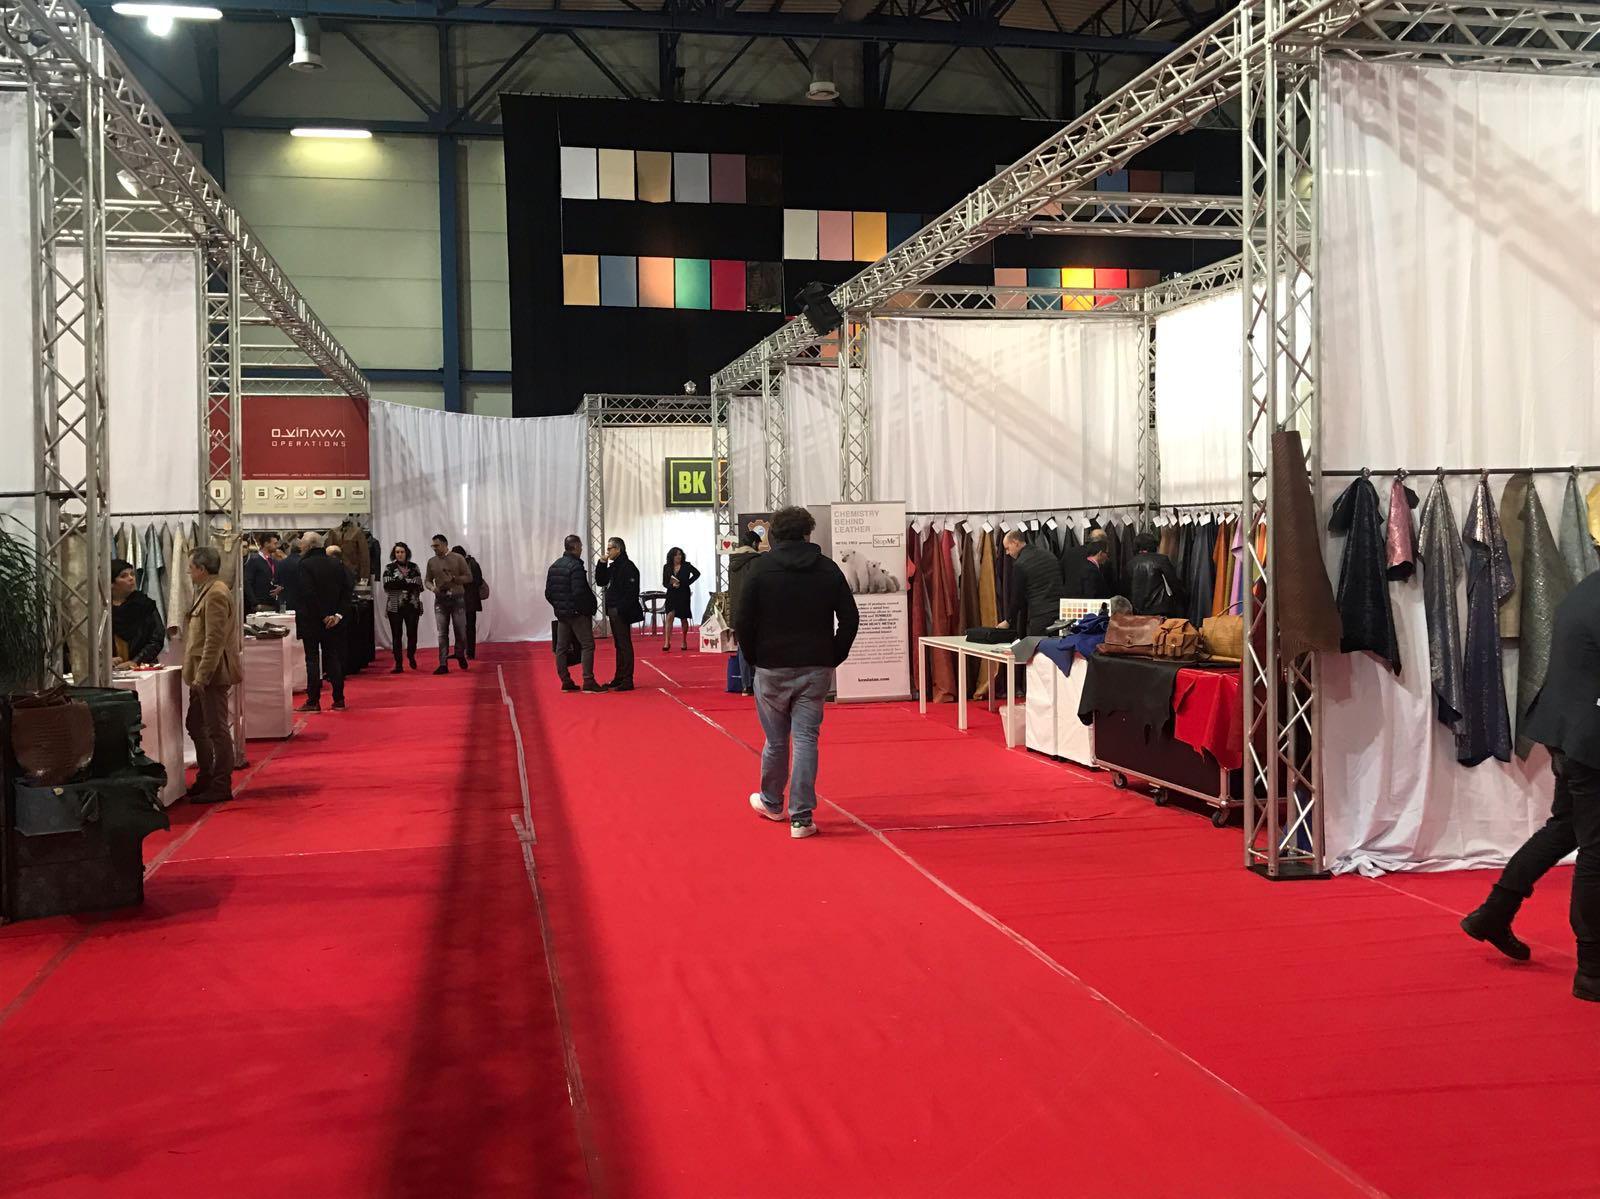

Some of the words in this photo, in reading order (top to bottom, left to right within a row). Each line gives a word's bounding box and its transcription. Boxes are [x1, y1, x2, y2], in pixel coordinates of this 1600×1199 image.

[678, 471, 706, 494] BK
[834, 510, 880, 518] CHEMISTRY
[834, 518, 865, 526] BEHIND
[834, 526, 871, 534] LEATHER
